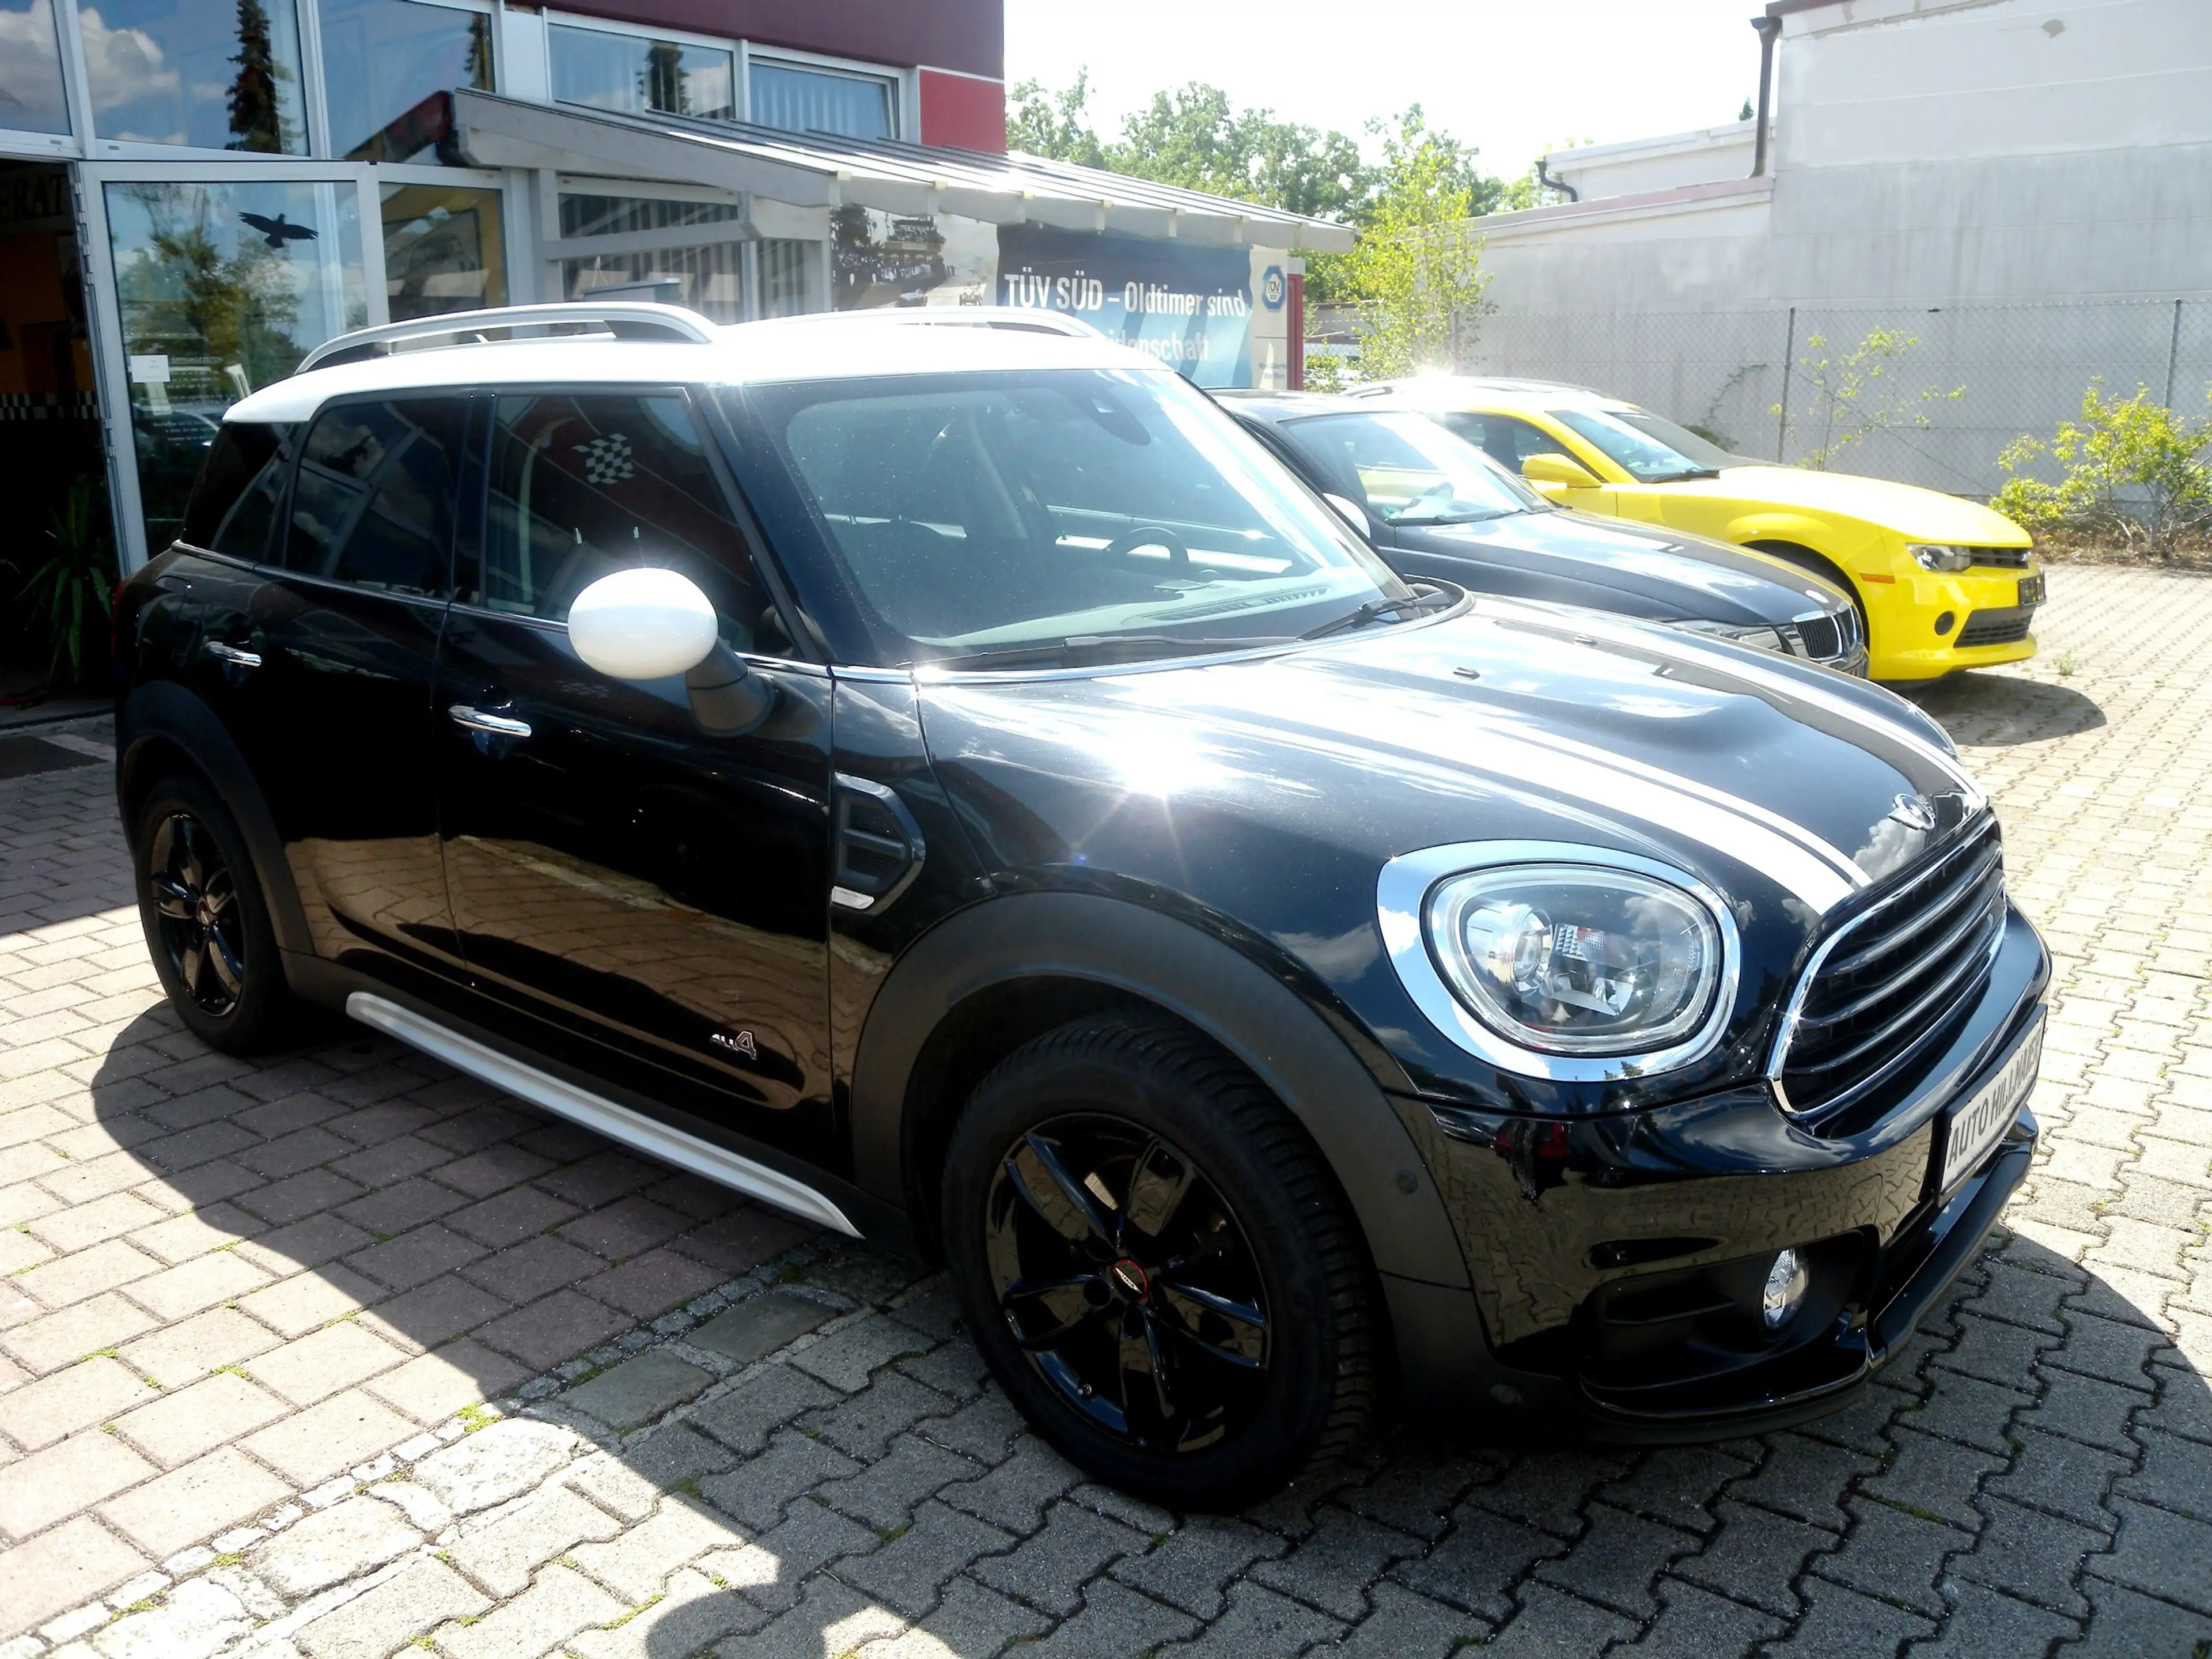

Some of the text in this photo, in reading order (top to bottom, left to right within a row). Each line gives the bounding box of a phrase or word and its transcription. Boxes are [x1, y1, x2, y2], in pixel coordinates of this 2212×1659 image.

[1004, 266, 1051, 308] TÜV
[1056, 270, 1103, 311] SÜD
[1125, 281, 1203, 316] Oldtimer
[1207, 288, 1245, 317] sind
[1267, 281, 1280, 291] TÜV
[1947, 1098, 1988, 1168] AUTO
